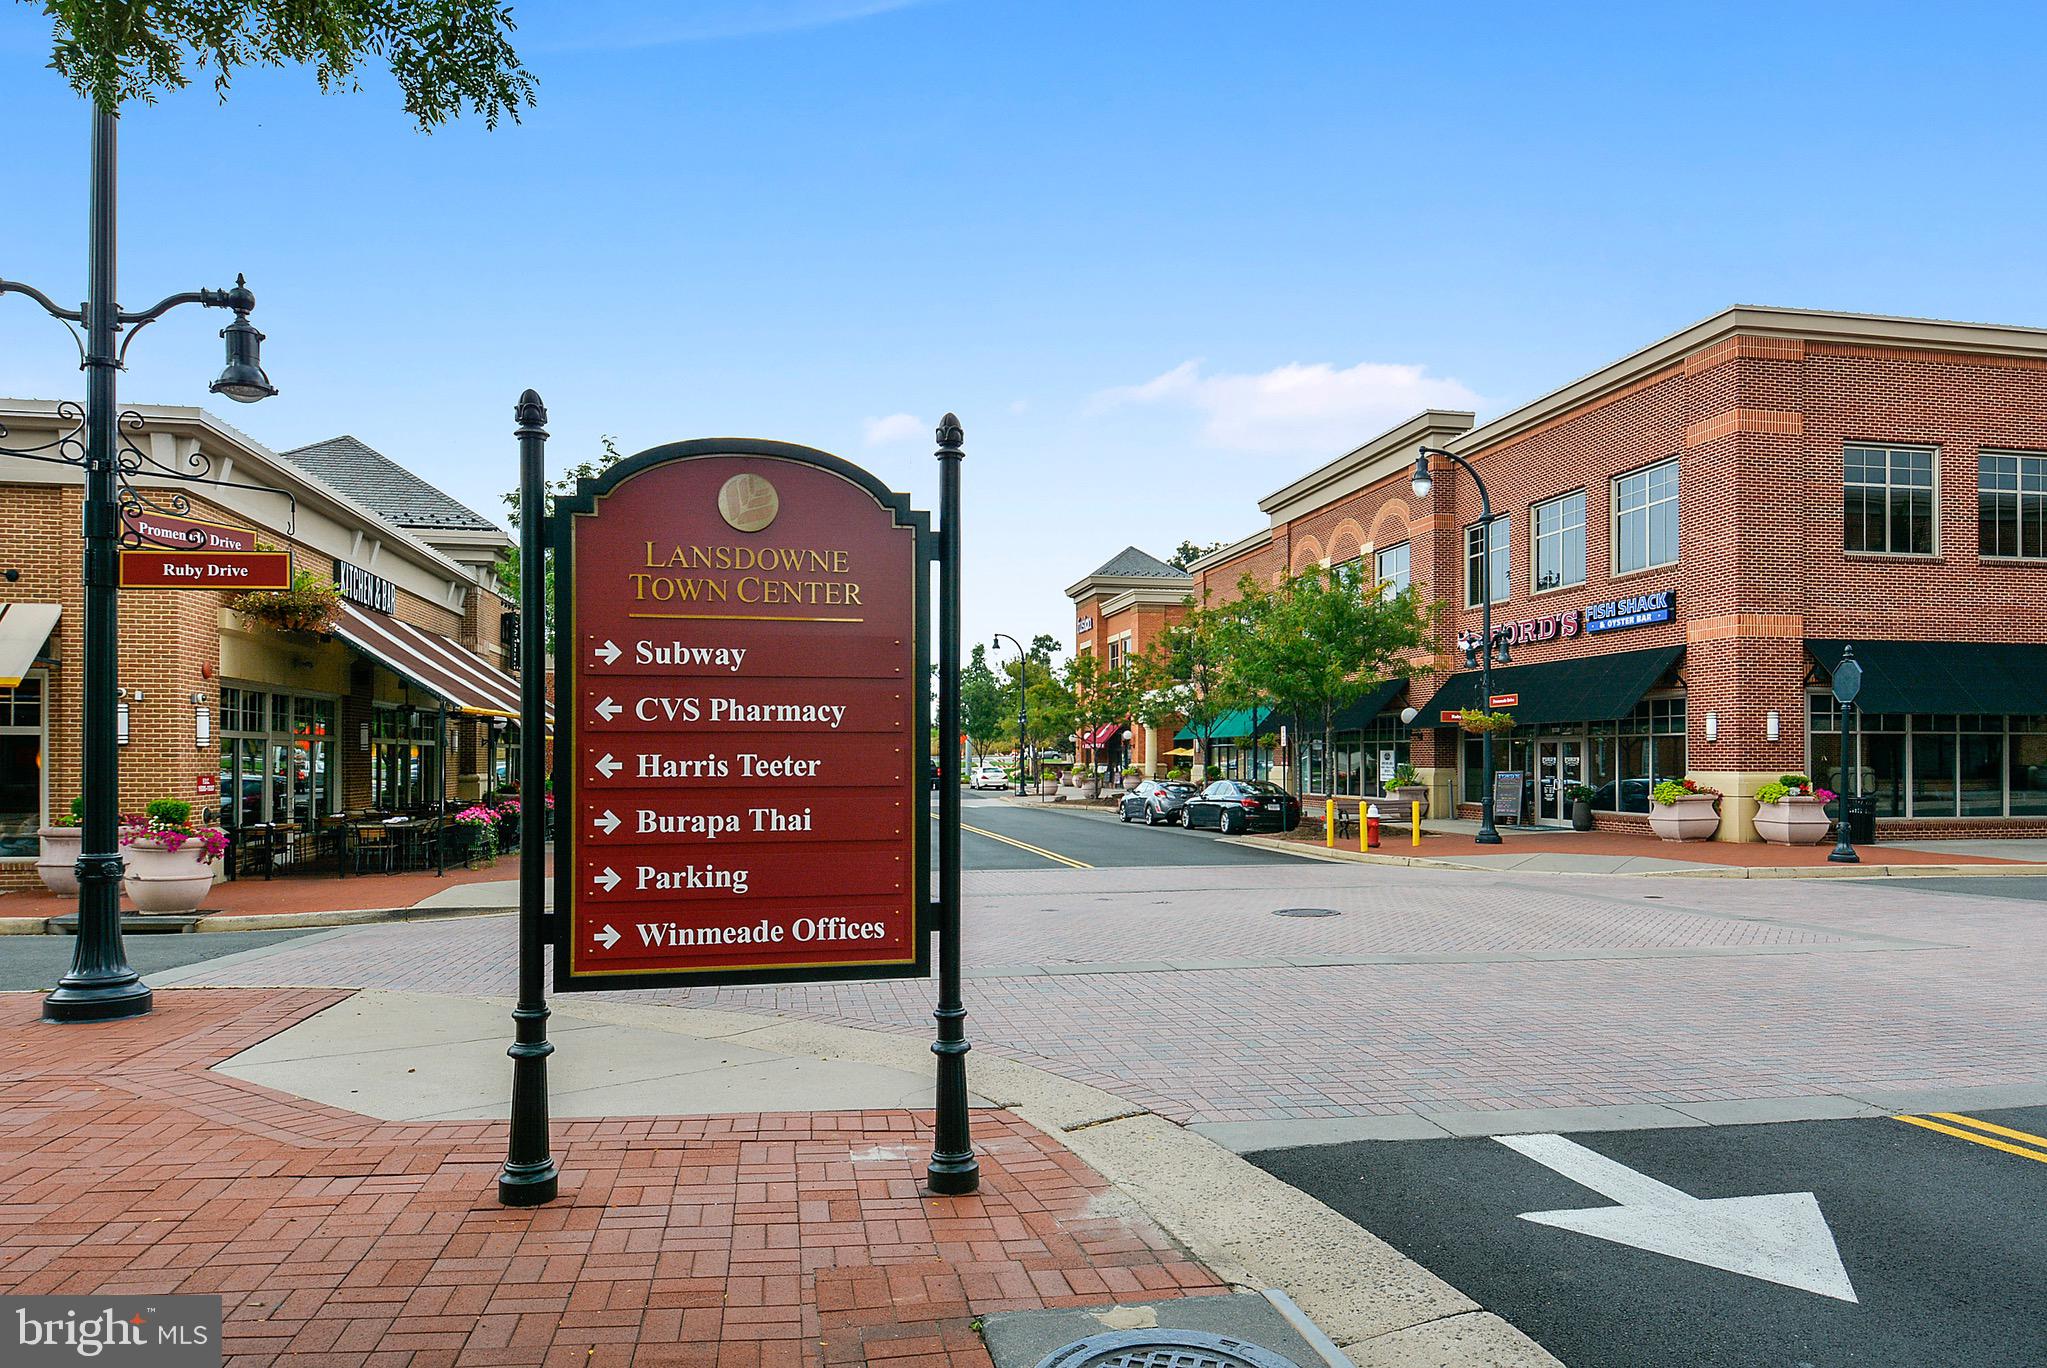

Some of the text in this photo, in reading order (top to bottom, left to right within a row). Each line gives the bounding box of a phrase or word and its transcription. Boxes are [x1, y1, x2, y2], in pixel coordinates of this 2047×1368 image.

[139, 522, 241, 550] Promend Drive
[163, 564, 248, 579] Ruby Drive
[644, 541, 850, 573] LANSDOWNE
[340, 561, 395, 614] KITCHEN & BAR
[628, 574, 863, 606] TOWN CENTER
[1586, 592, 1668, 620] FISH SHACK
[1607, 616, 1635, 627] OYSTER
[1637, 613, 1652, 622] BAR
[635, 639, 747, 671] Subway
[635, 697, 846, 728] CVS Pharmacy
[636, 754, 821, 778] Harris Teeter
[636, 808, 812, 838] Burapa Thai
[636, 864, 749, 895] Parking
[636, 918, 886, 947] Winmeade Offices
